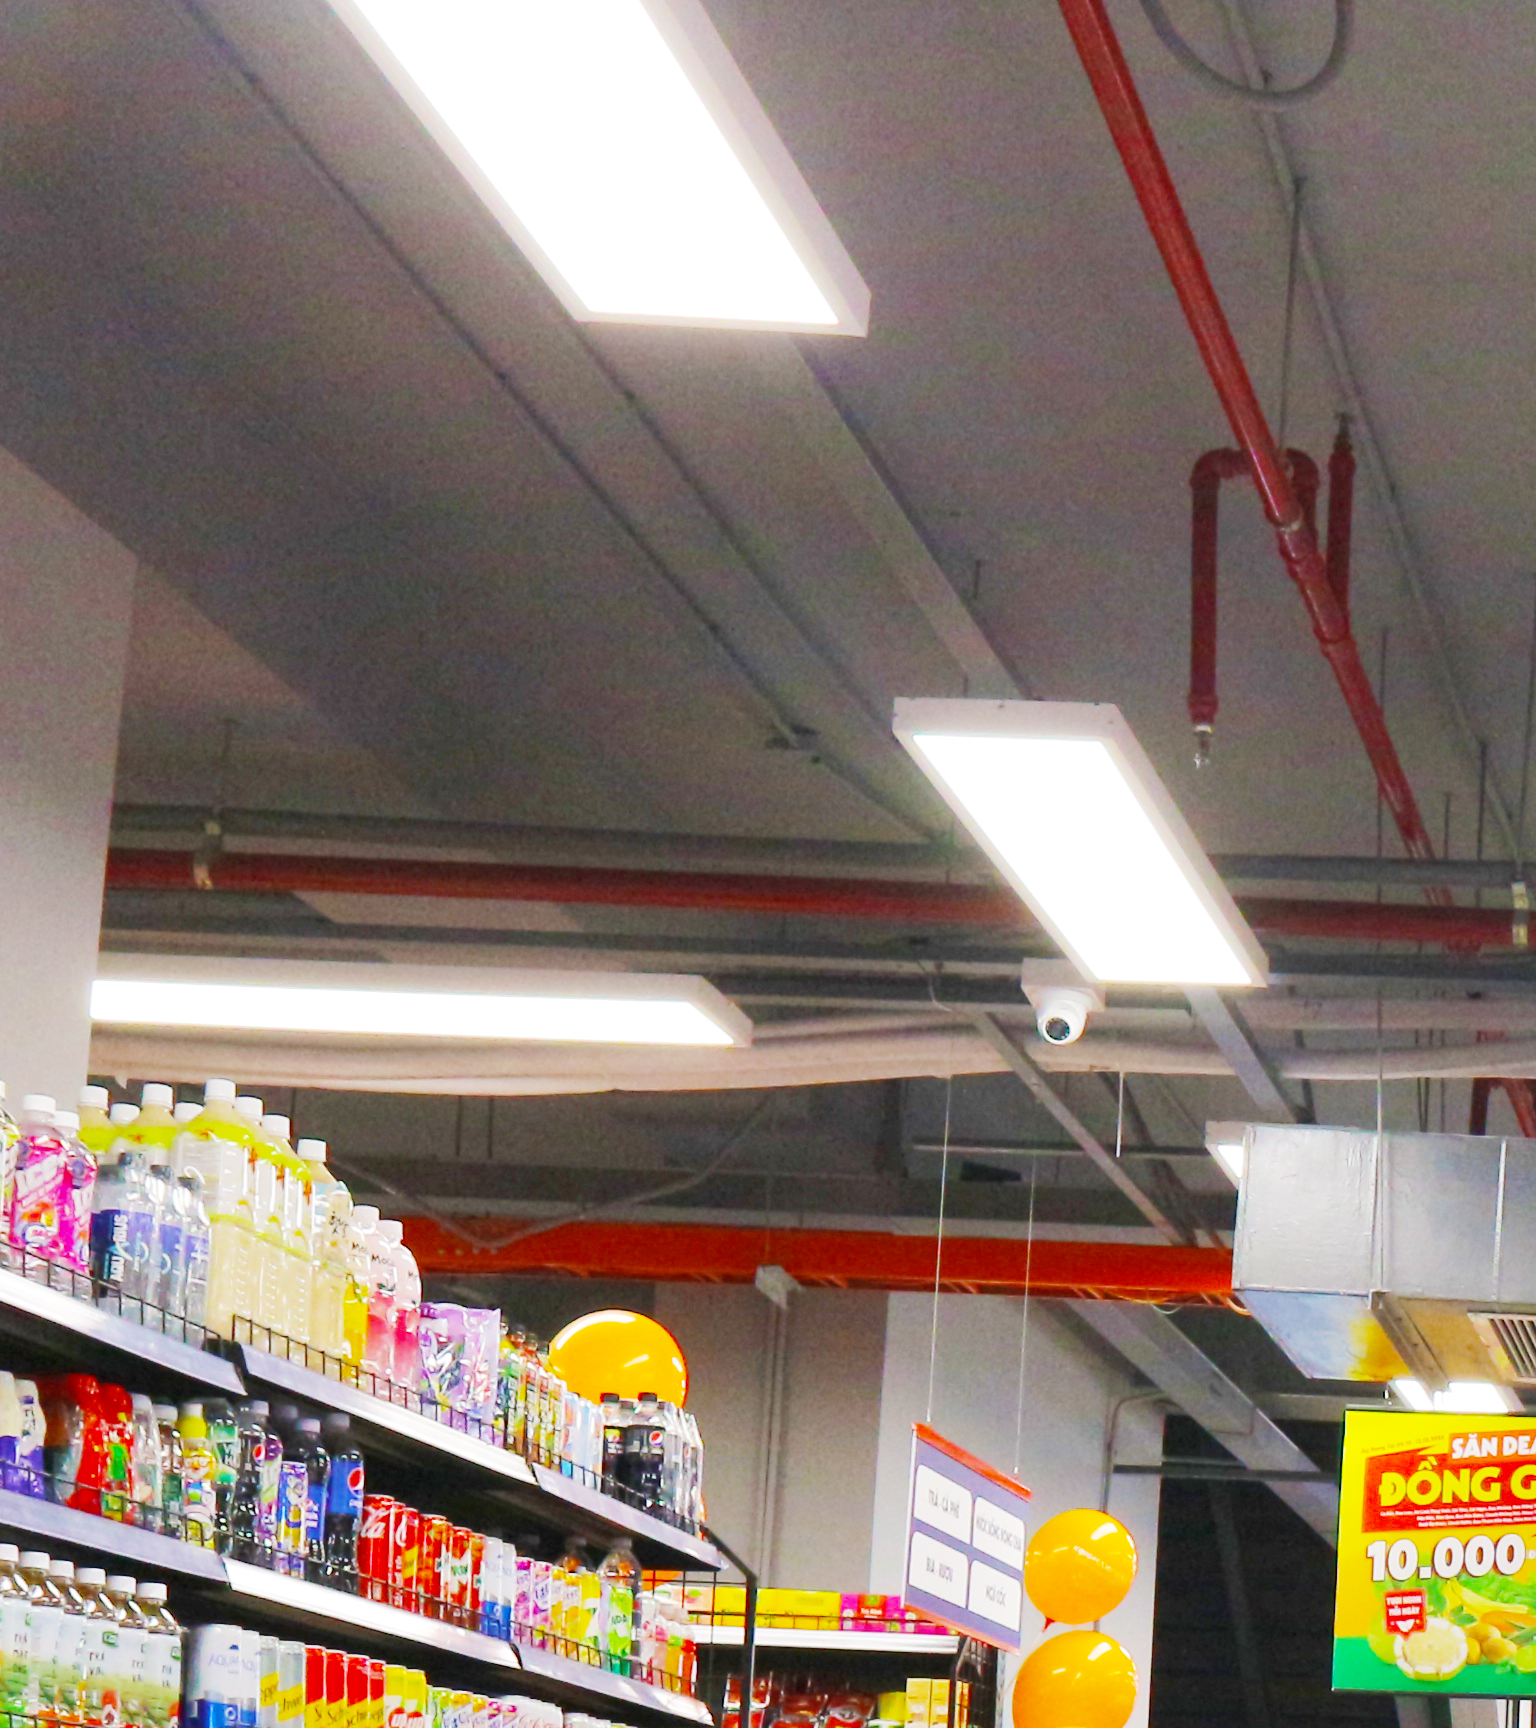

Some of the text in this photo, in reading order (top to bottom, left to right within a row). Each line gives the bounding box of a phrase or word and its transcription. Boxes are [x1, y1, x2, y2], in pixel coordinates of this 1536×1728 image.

[1451, 1433, 1498, 1460] SĂN
[1379, 1456, 1502, 1507] ĐỒNG
[1367, 1533, 1526, 1582] 10.000
